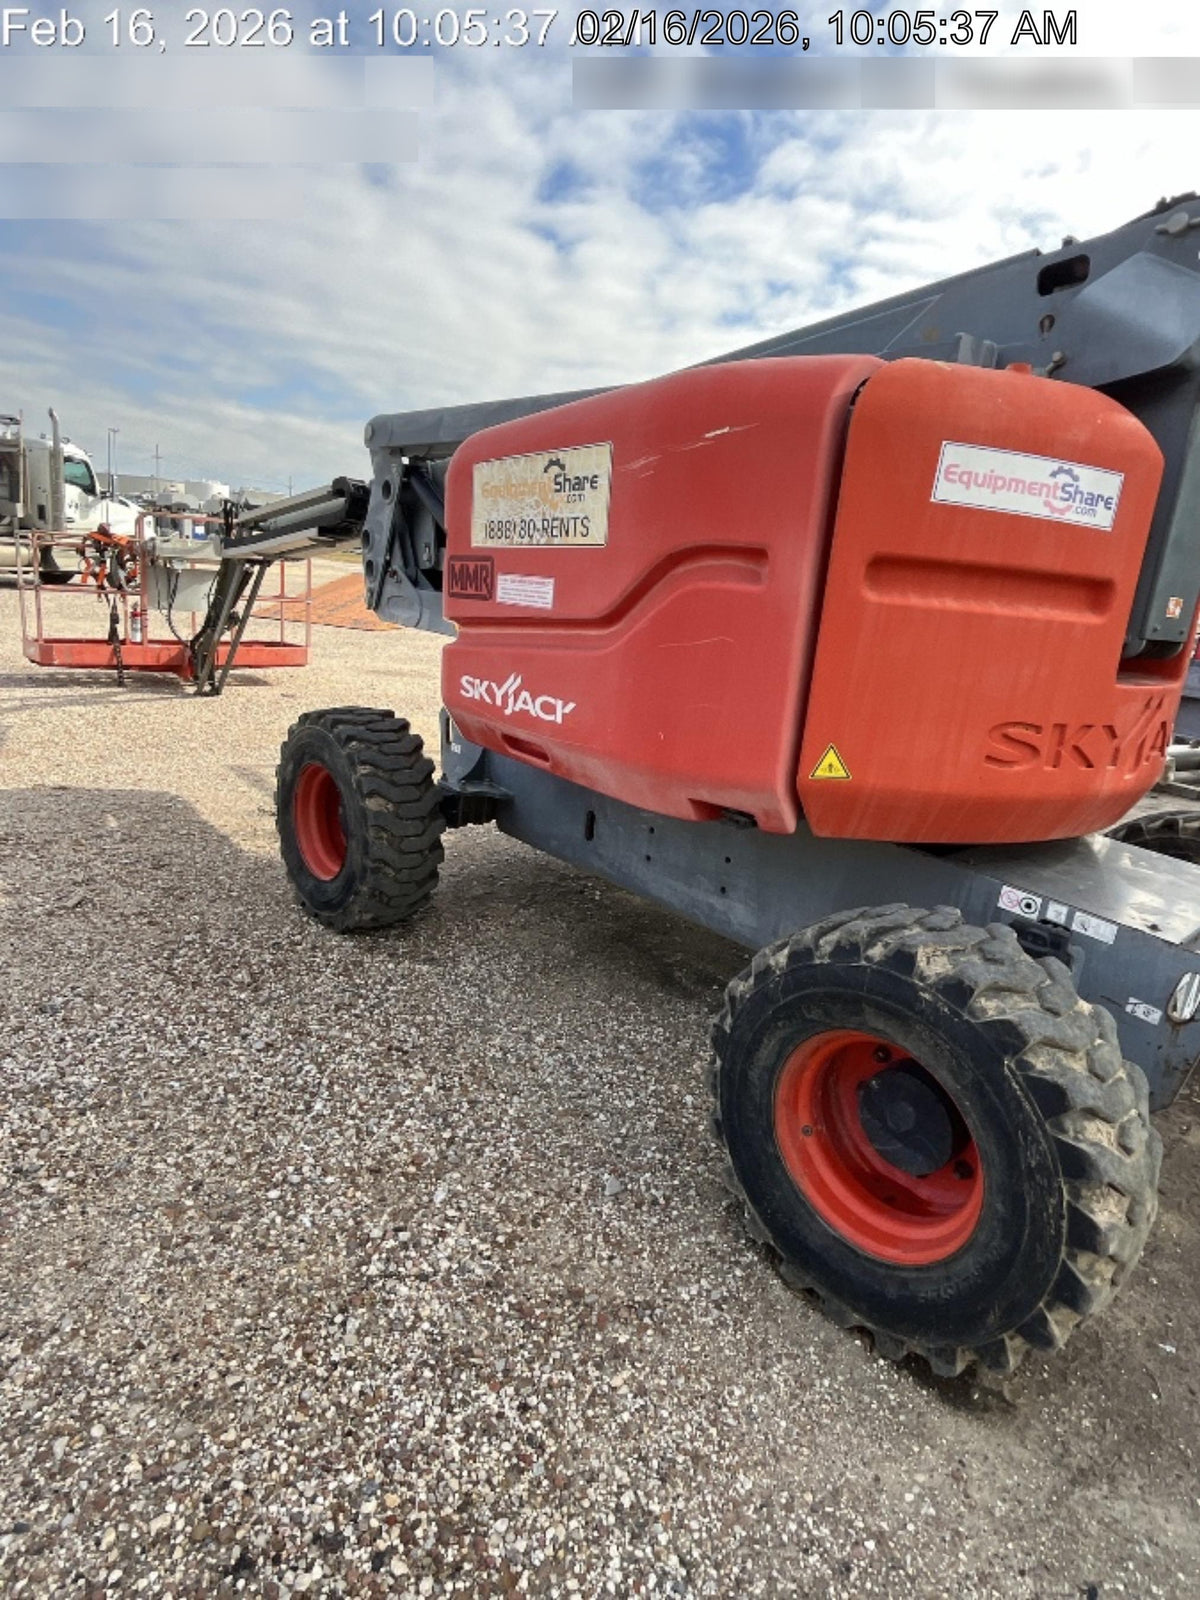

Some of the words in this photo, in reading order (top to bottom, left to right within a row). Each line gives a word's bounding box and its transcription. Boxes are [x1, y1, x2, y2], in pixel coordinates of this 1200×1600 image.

[943, 463, 1115, 511] EquipmentShare
[1072, 505, 1098, 519] .com
[450, 562, 492, 600] MMR
[983, 694, 1170, 780] SKYJA
